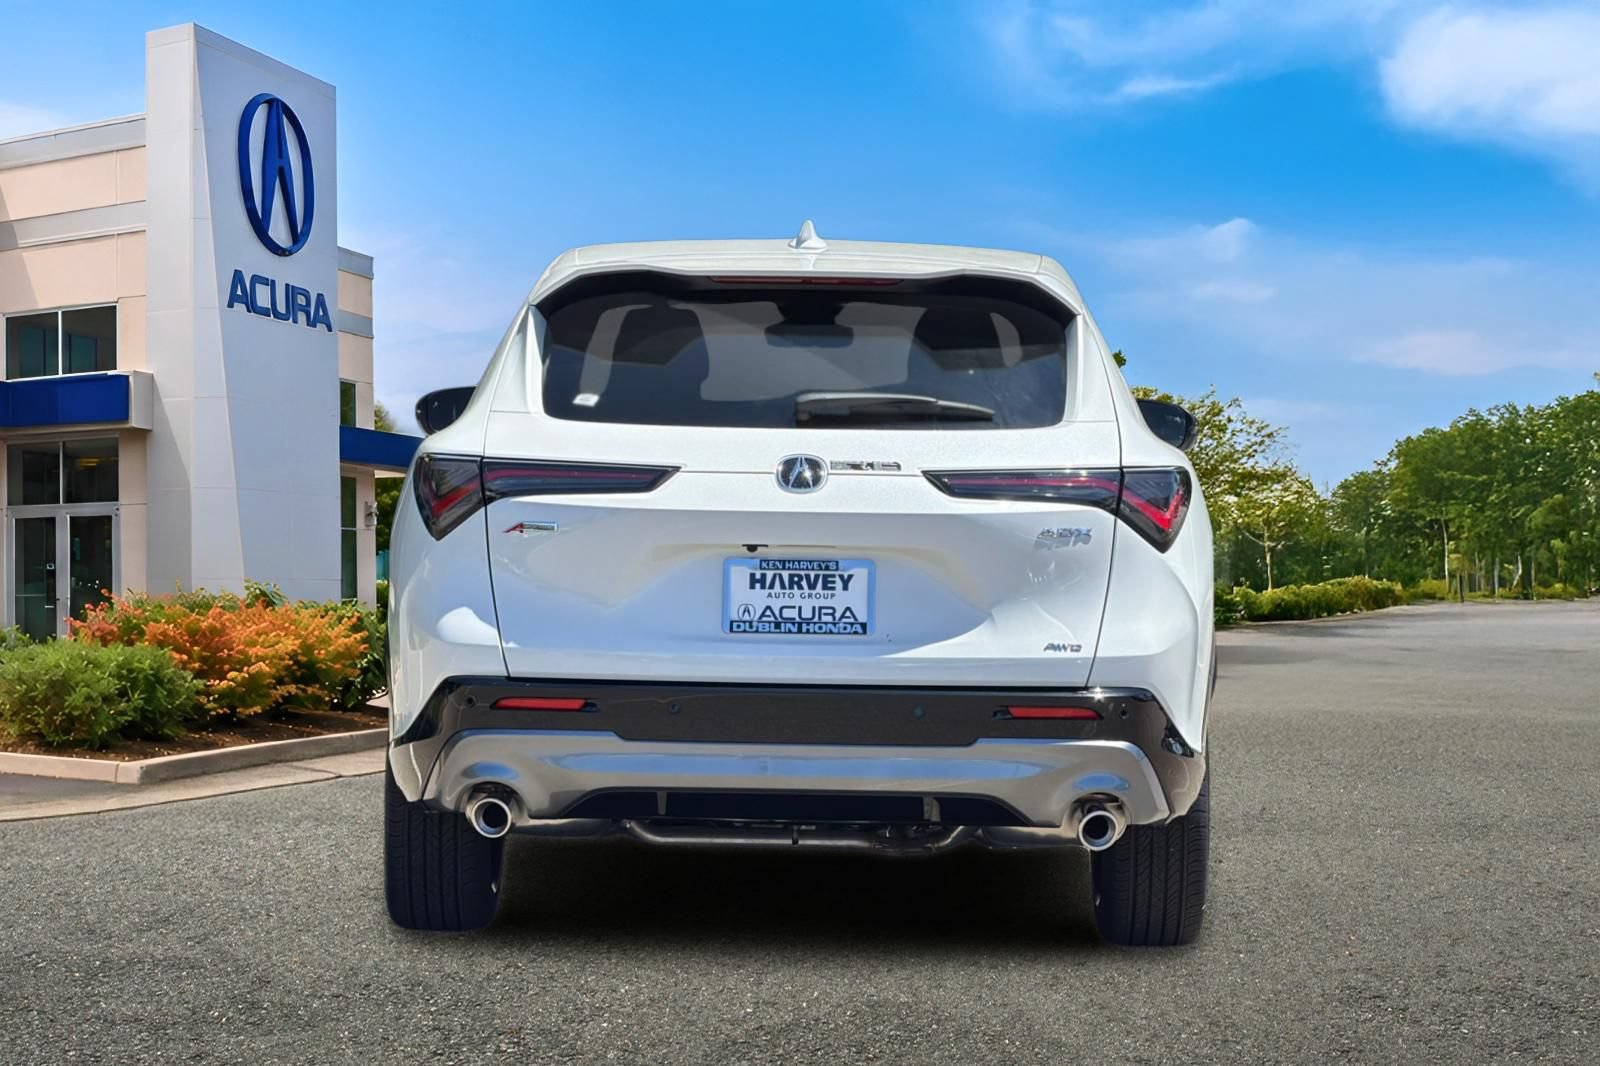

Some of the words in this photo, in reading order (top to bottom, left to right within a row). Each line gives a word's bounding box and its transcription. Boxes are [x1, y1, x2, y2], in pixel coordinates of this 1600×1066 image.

[227, 269, 333, 332] ACURA
[761, 560, 782, 569] KEN
[785, 561, 837, 570] HARVEY'S
[749, 572, 855, 591] HARVEY
[766, 591, 795, 600] AUTO
[800, 591, 836, 600] GROUP
[758, 605, 859, 622] ACURA
[732, 622, 798, 632] DUBLIN
[801, 622, 864, 633] HONDA
